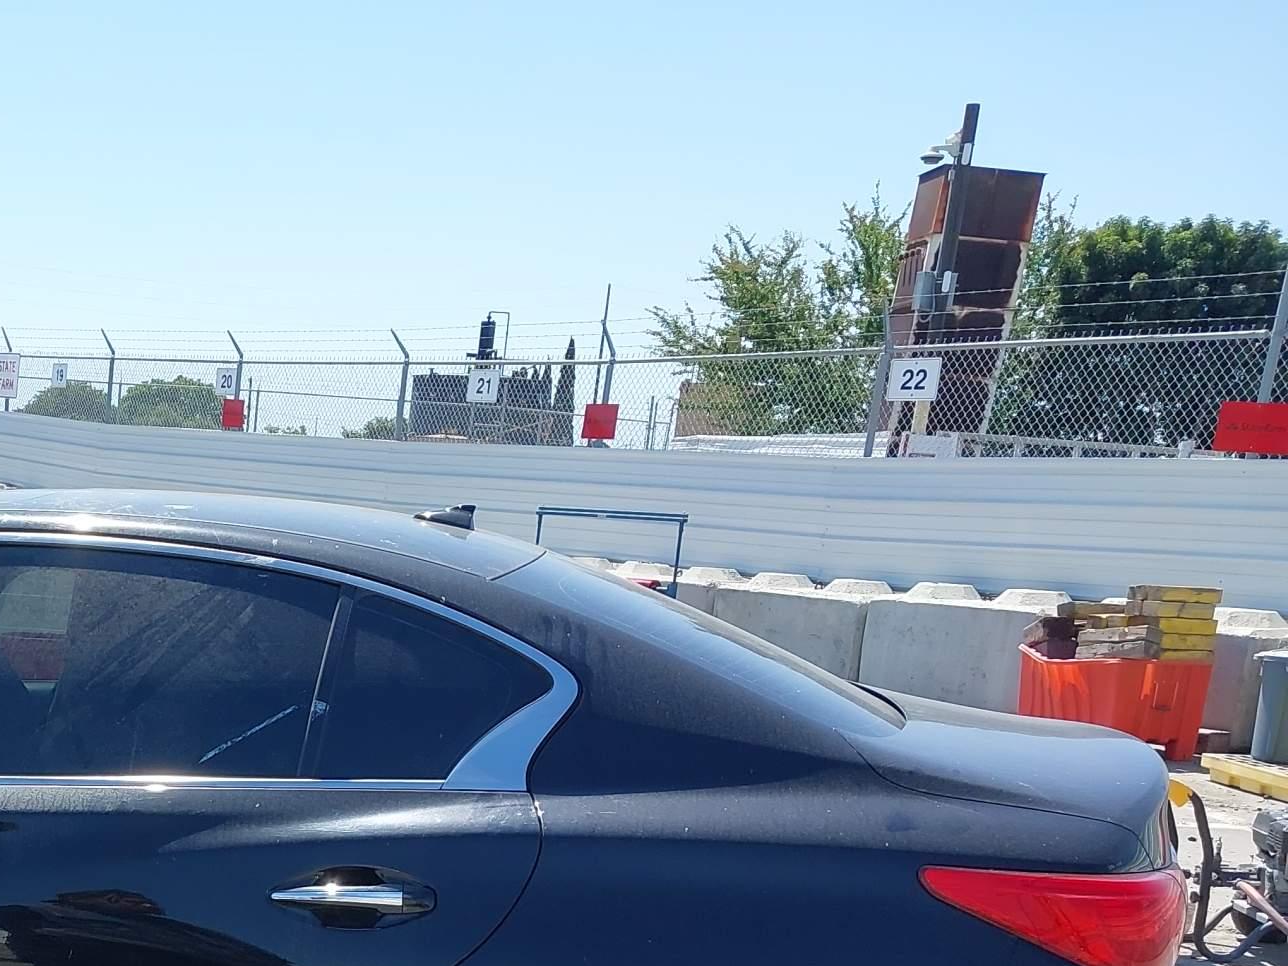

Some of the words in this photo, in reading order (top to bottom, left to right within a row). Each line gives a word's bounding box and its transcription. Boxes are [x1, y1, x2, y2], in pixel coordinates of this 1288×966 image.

[56, 368, 64, 382] 19
[220, 374, 233, 389] 20
[899, 368, 928, 391] 22
[475, 377, 492, 395] 21
